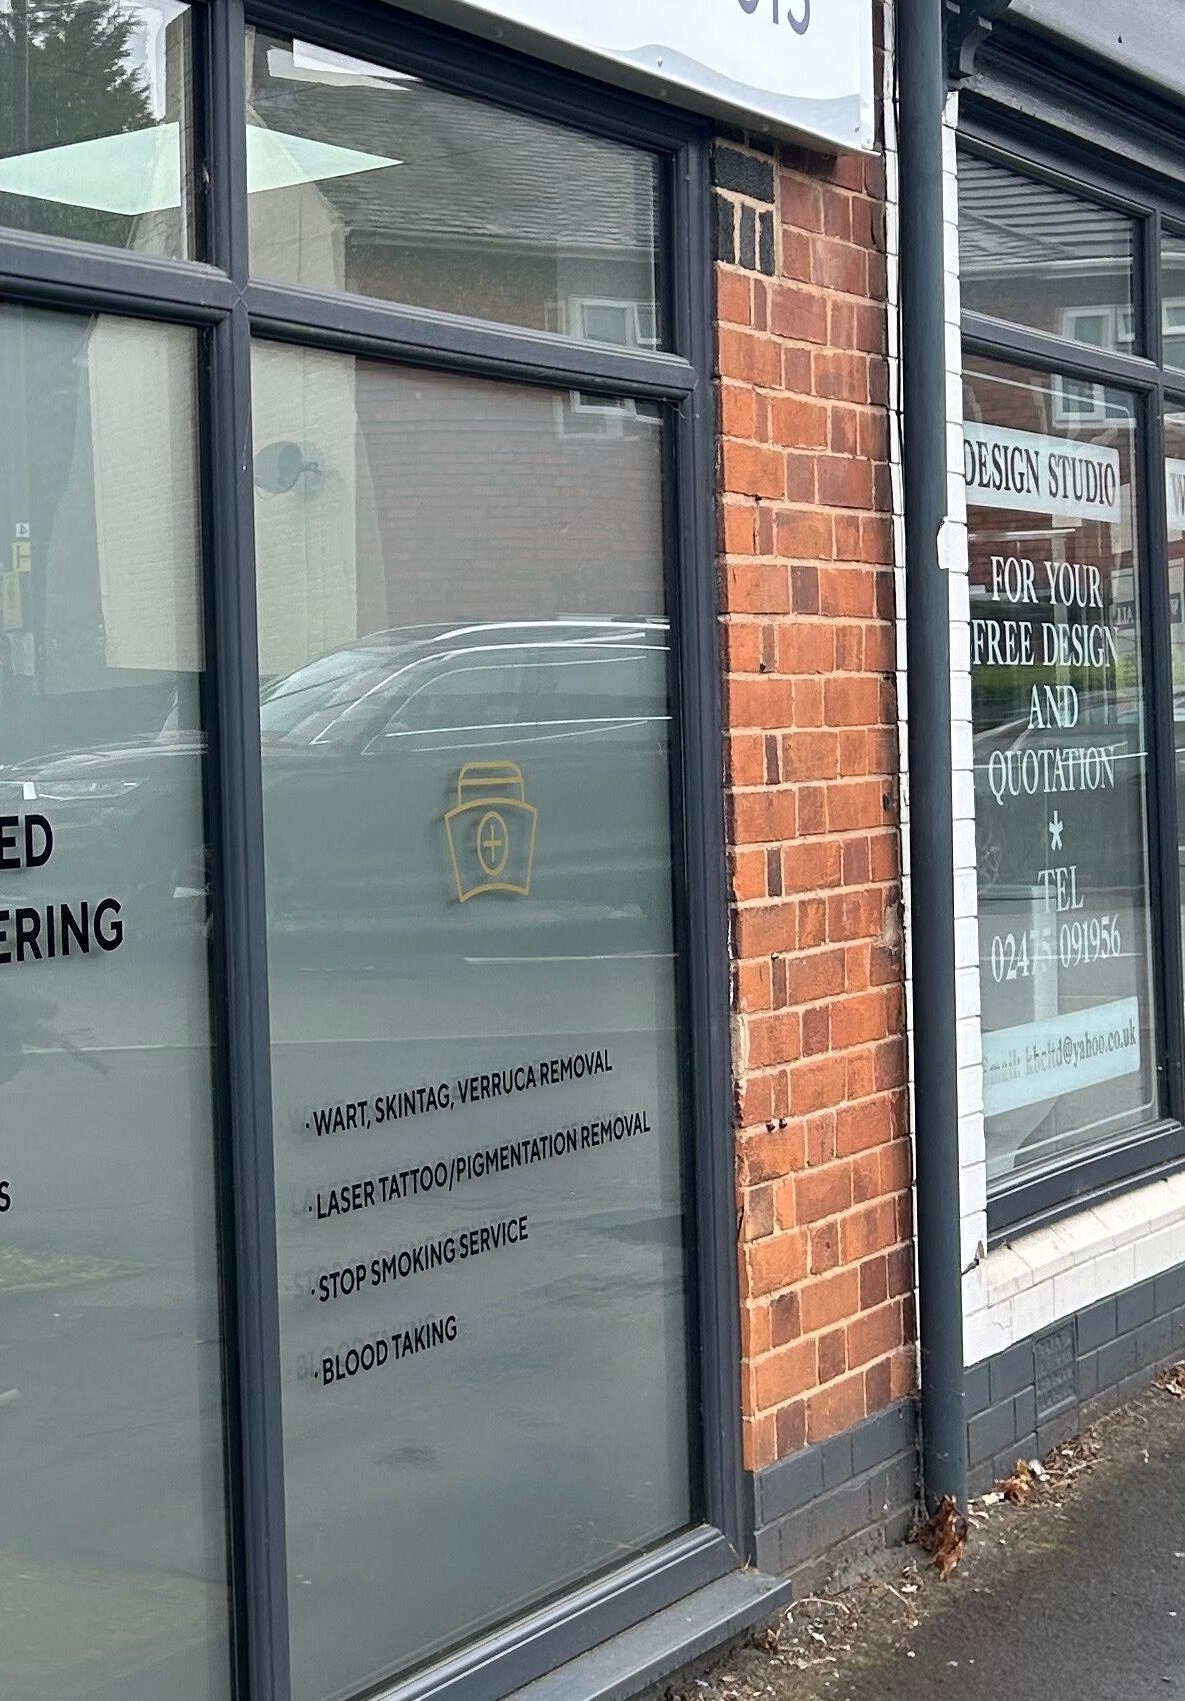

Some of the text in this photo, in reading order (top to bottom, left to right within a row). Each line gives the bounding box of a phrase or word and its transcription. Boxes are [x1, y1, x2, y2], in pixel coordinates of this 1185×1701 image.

[964, 440, 1040, 496] DESIGN
[1049, 452, 1116, 507] STUDIO
[991, 556, 1103, 607] FOR YOUR
[971, 620, 1119, 667] FREE DESIGN
[1028, 684, 1079, 729] AND
[989, 745, 1115, 806] QUOTATION
[1038, 865, 1084, 914] TEL
[991, 914, 1120, 982] 02475 091956
[312, 1050, 612, 1137] WART, SKINTAG, VERRUCA REMOVAL
[317, 1111, 650, 1219] LASER TATTOO/PIGMENTATION REMOVAL
[320, 1216, 528, 1302] STOP SMOKING SERVICE
[323, 1316, 457, 1385] BLOOD TAKING
